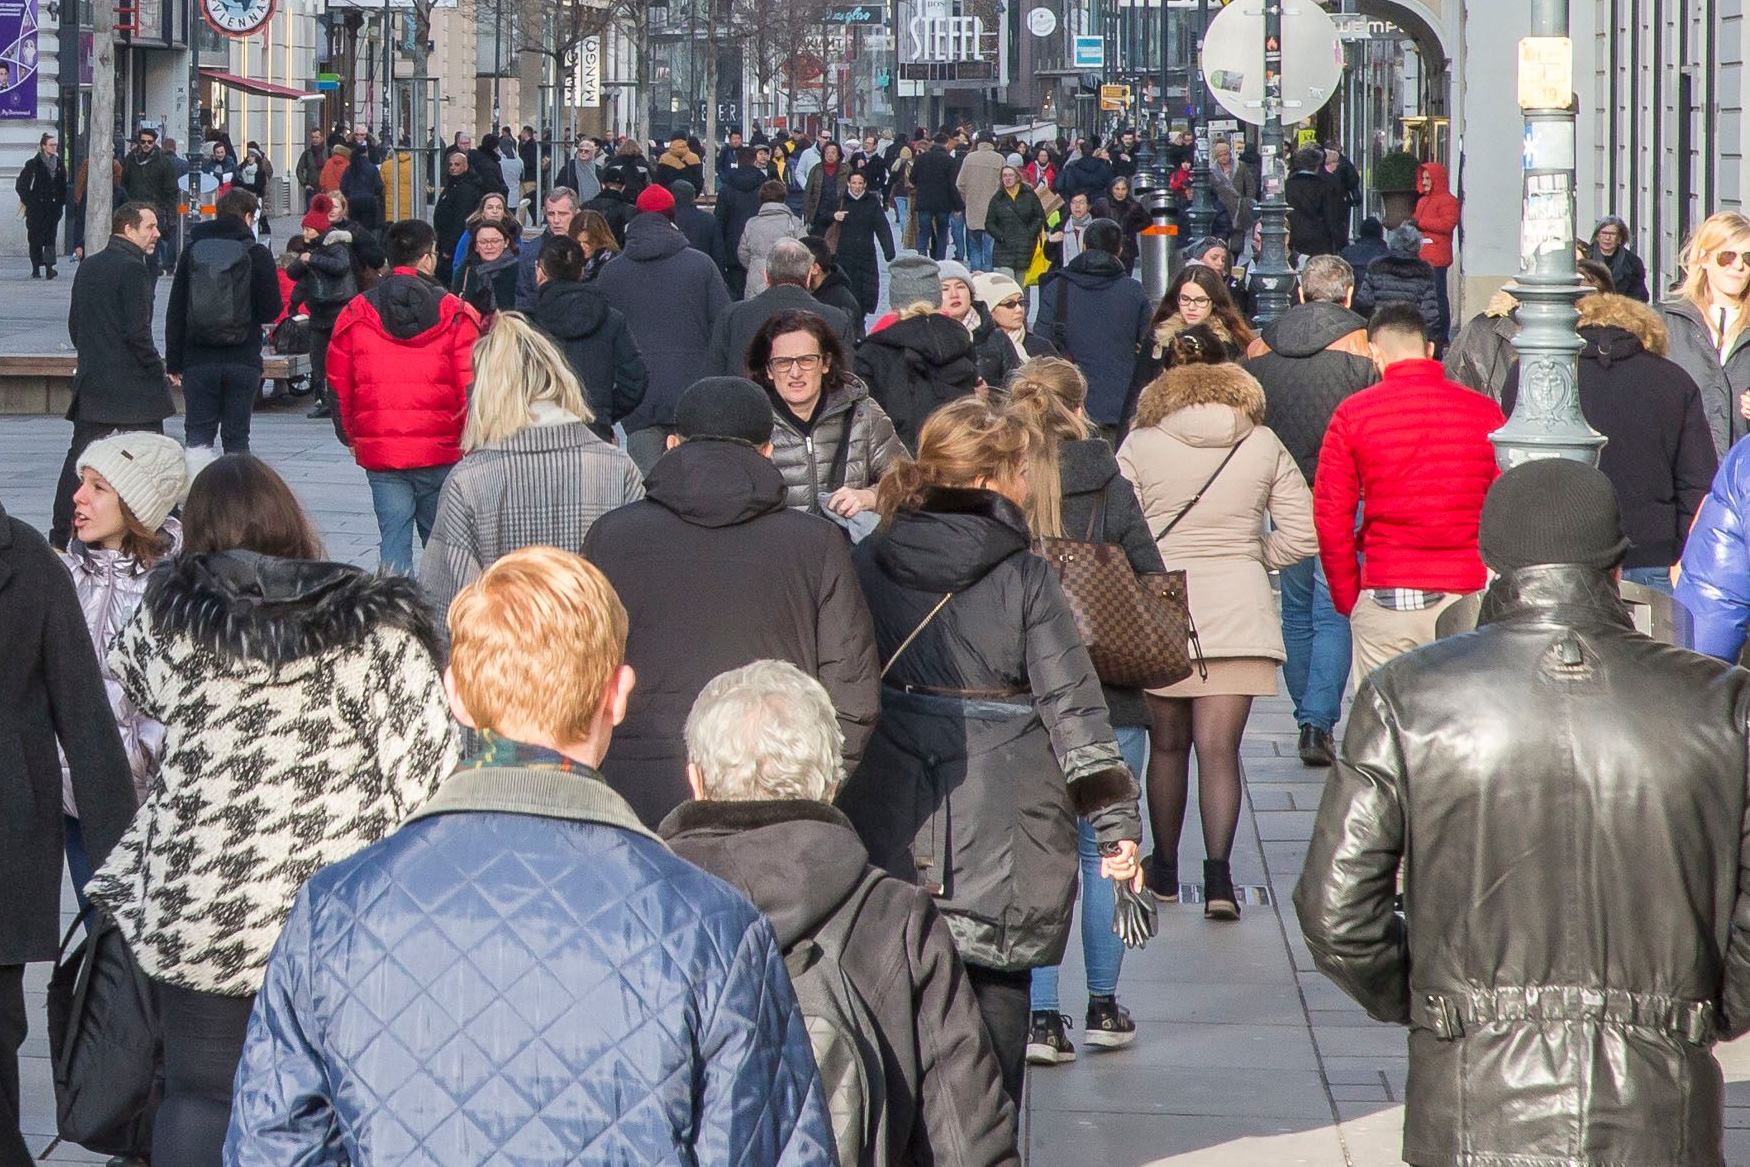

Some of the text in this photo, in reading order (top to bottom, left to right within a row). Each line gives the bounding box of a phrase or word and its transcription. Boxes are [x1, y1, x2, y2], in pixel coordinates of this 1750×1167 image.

[211, 5, 267, 28] VIENNA
[910, 16, 985, 61] STEFFL
[585, 40, 598, 102] MANGO
